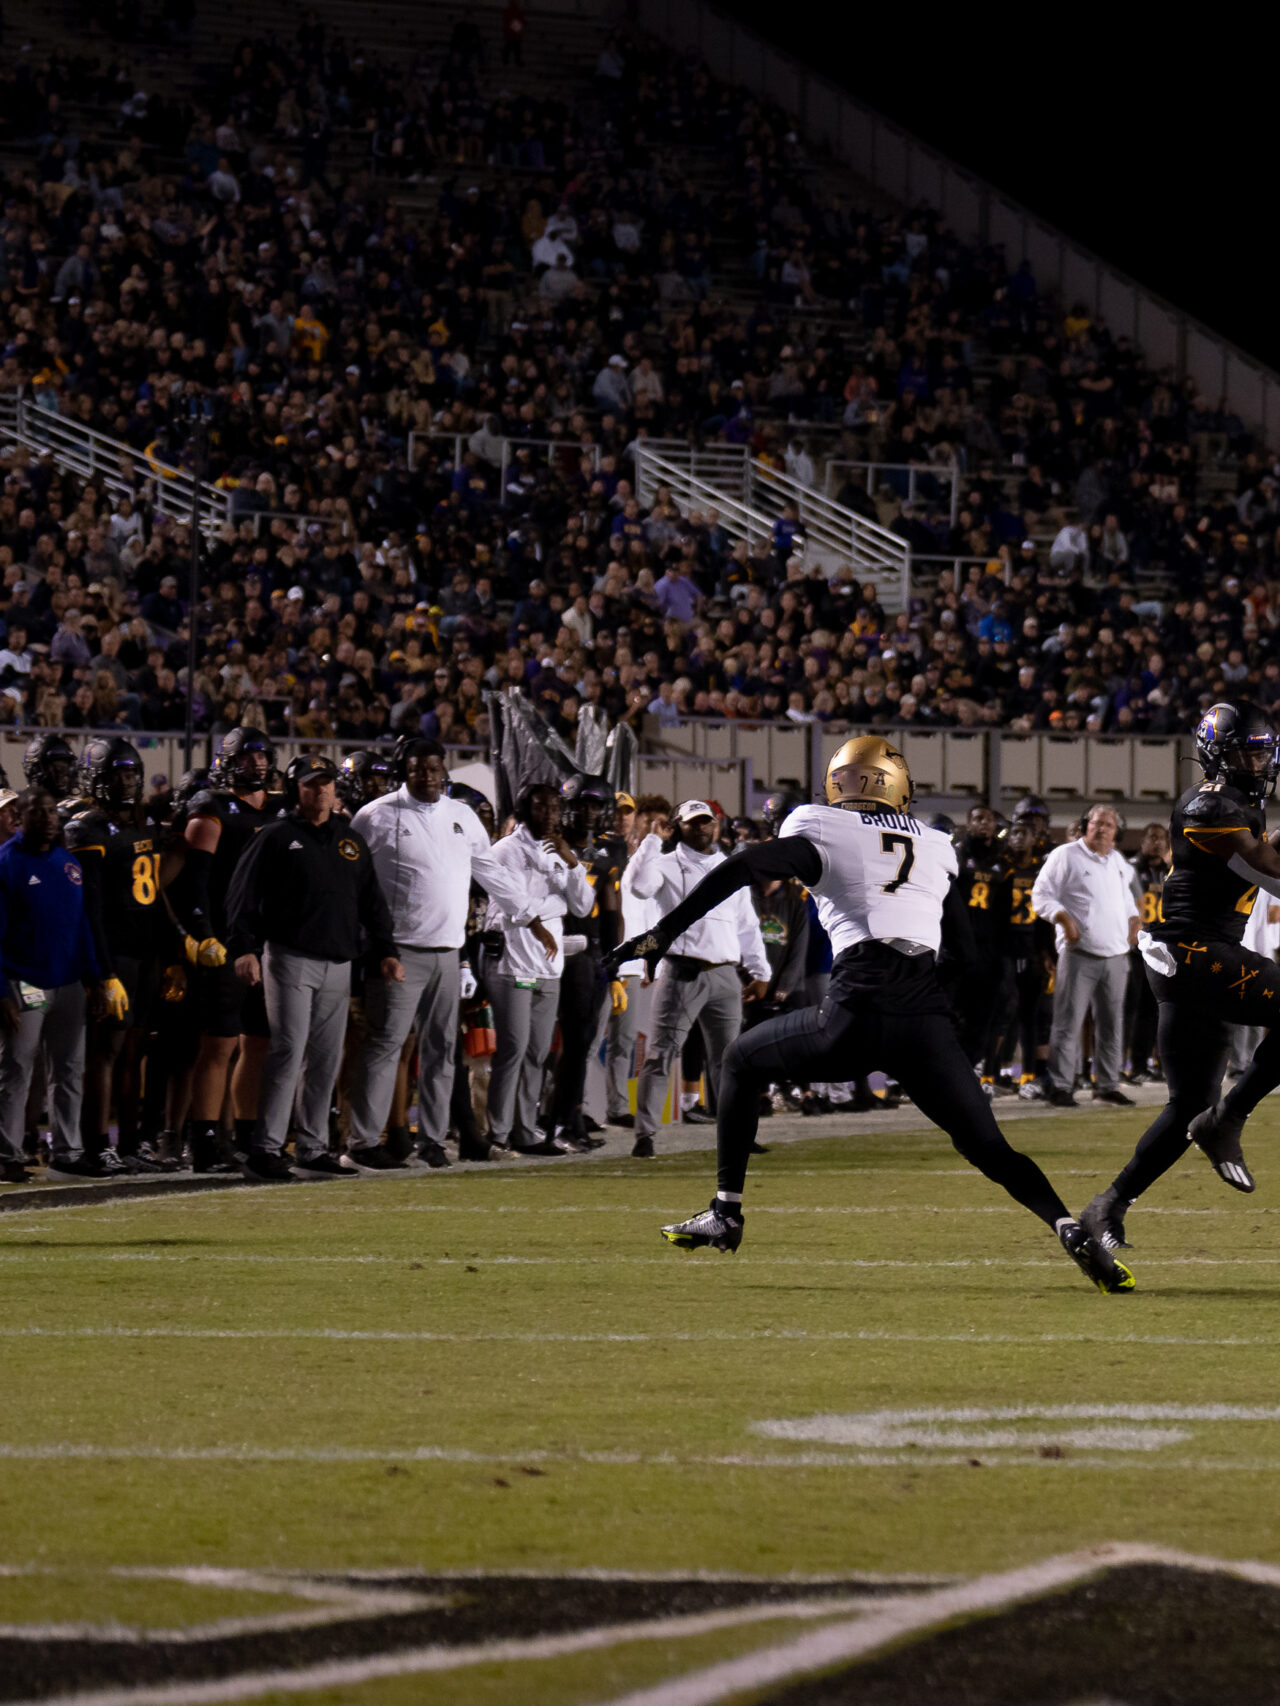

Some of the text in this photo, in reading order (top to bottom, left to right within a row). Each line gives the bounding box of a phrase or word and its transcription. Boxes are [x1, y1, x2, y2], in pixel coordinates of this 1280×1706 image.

[860, 775, 868, 793] 7
[860, 811, 922, 836] BROWN
[880, 831, 916, 895] 7
